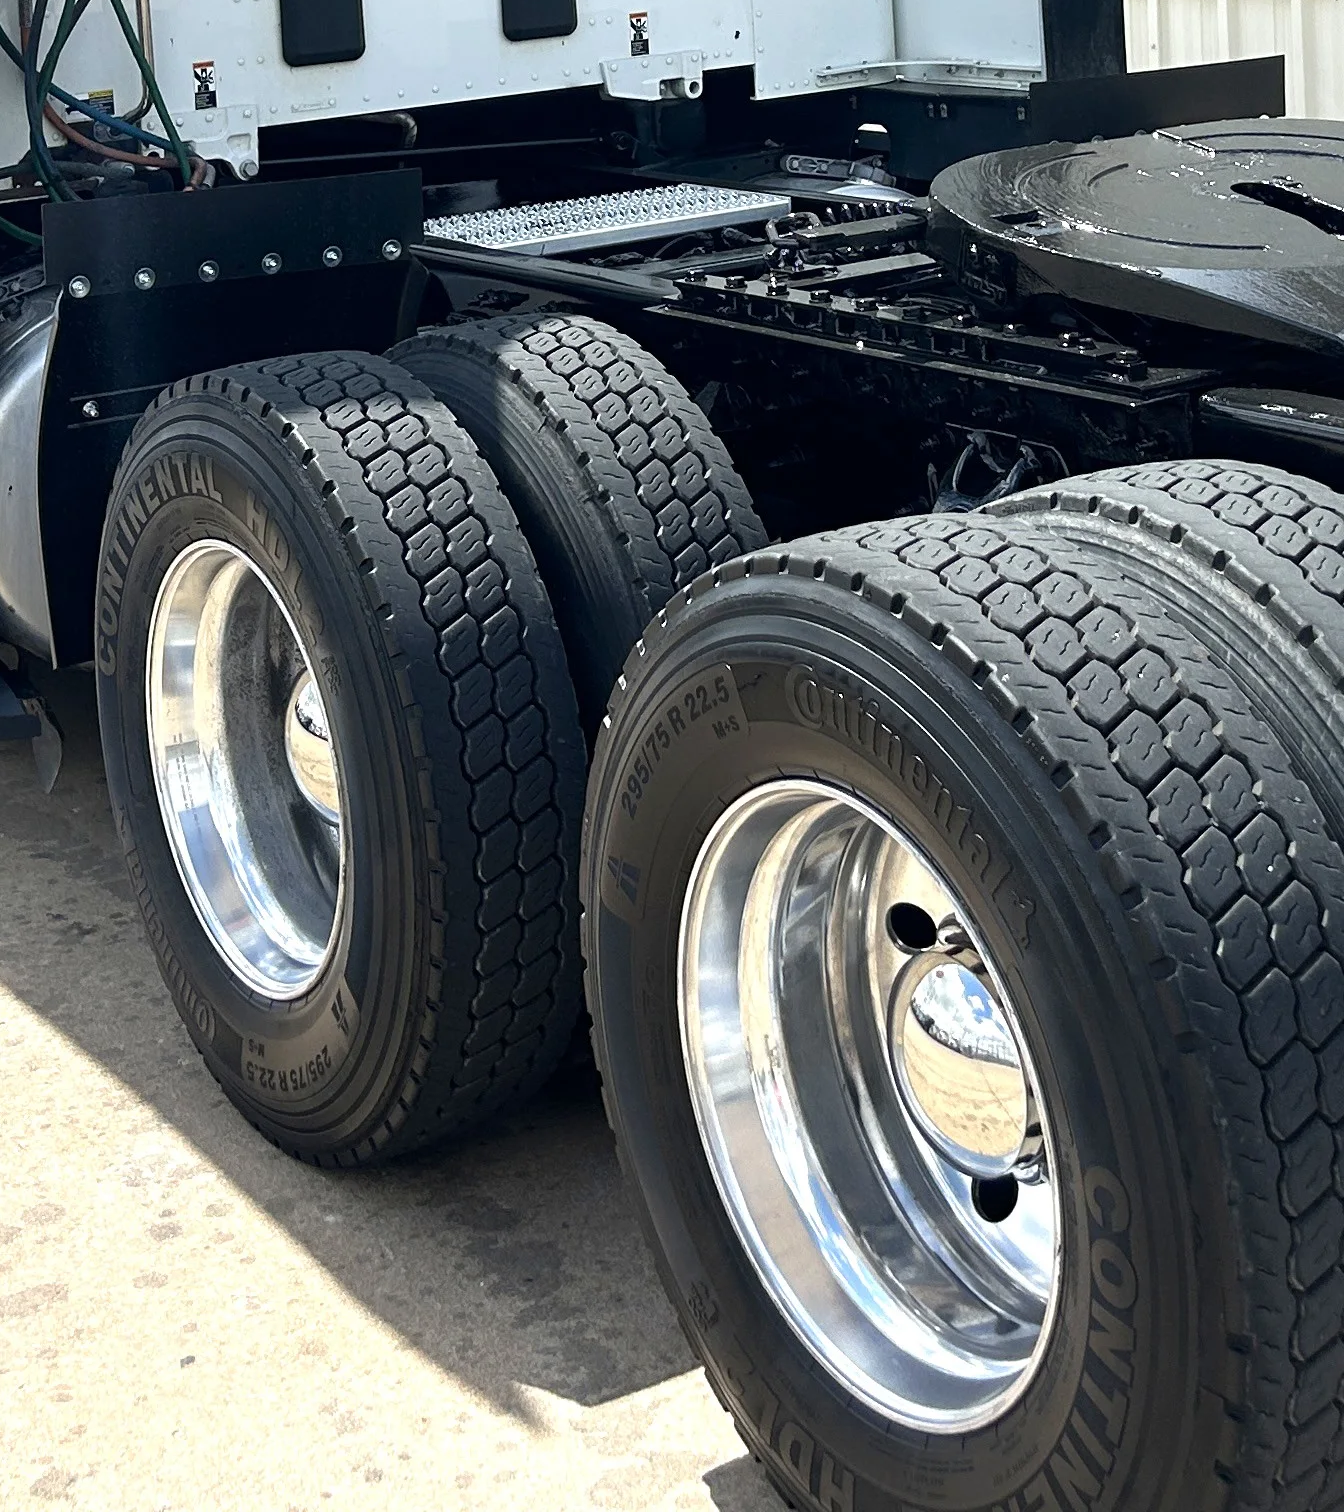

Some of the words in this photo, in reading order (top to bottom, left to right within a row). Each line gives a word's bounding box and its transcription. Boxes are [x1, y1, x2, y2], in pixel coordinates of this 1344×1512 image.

[98, 448, 223, 677] CONTINENTAL
[621, 720, 671, 820] 295/75
[666, 705, 687, 736] R
[684, 675, 730, 722] 22.5
[784, 662, 1015, 905] Continental
[246, 1061, 277, 1091] 22.5
[278, 1071, 289, 1092] R
[290, 1045, 331, 1090] 295/75
